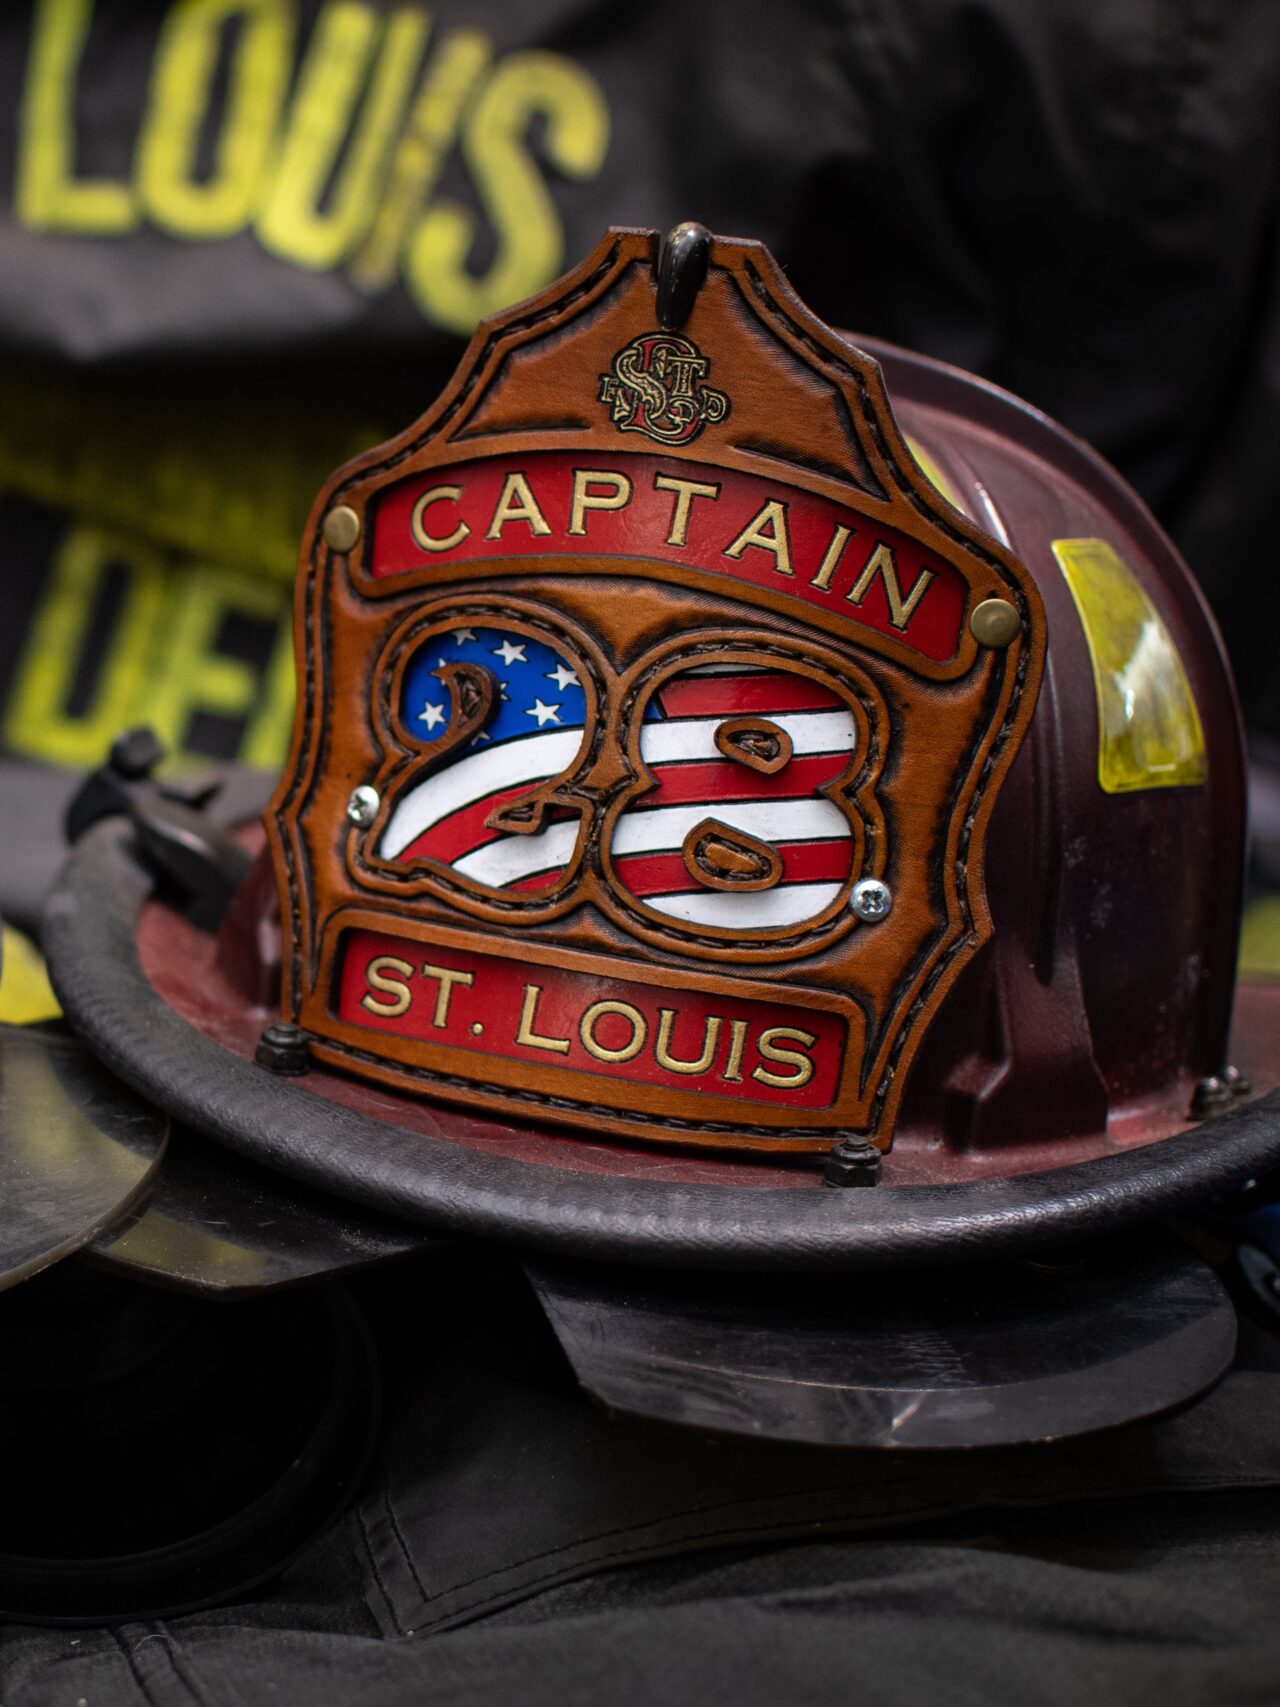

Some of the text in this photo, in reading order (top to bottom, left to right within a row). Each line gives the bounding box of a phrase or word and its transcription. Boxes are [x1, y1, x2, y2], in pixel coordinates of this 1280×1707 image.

[14, 0, 609, 335] LOUIS
[410, 468, 937, 633] CAPTAIN
[378, 626, 858, 931] 28
[361, 954, 819, 1091] ST. LOUIS
